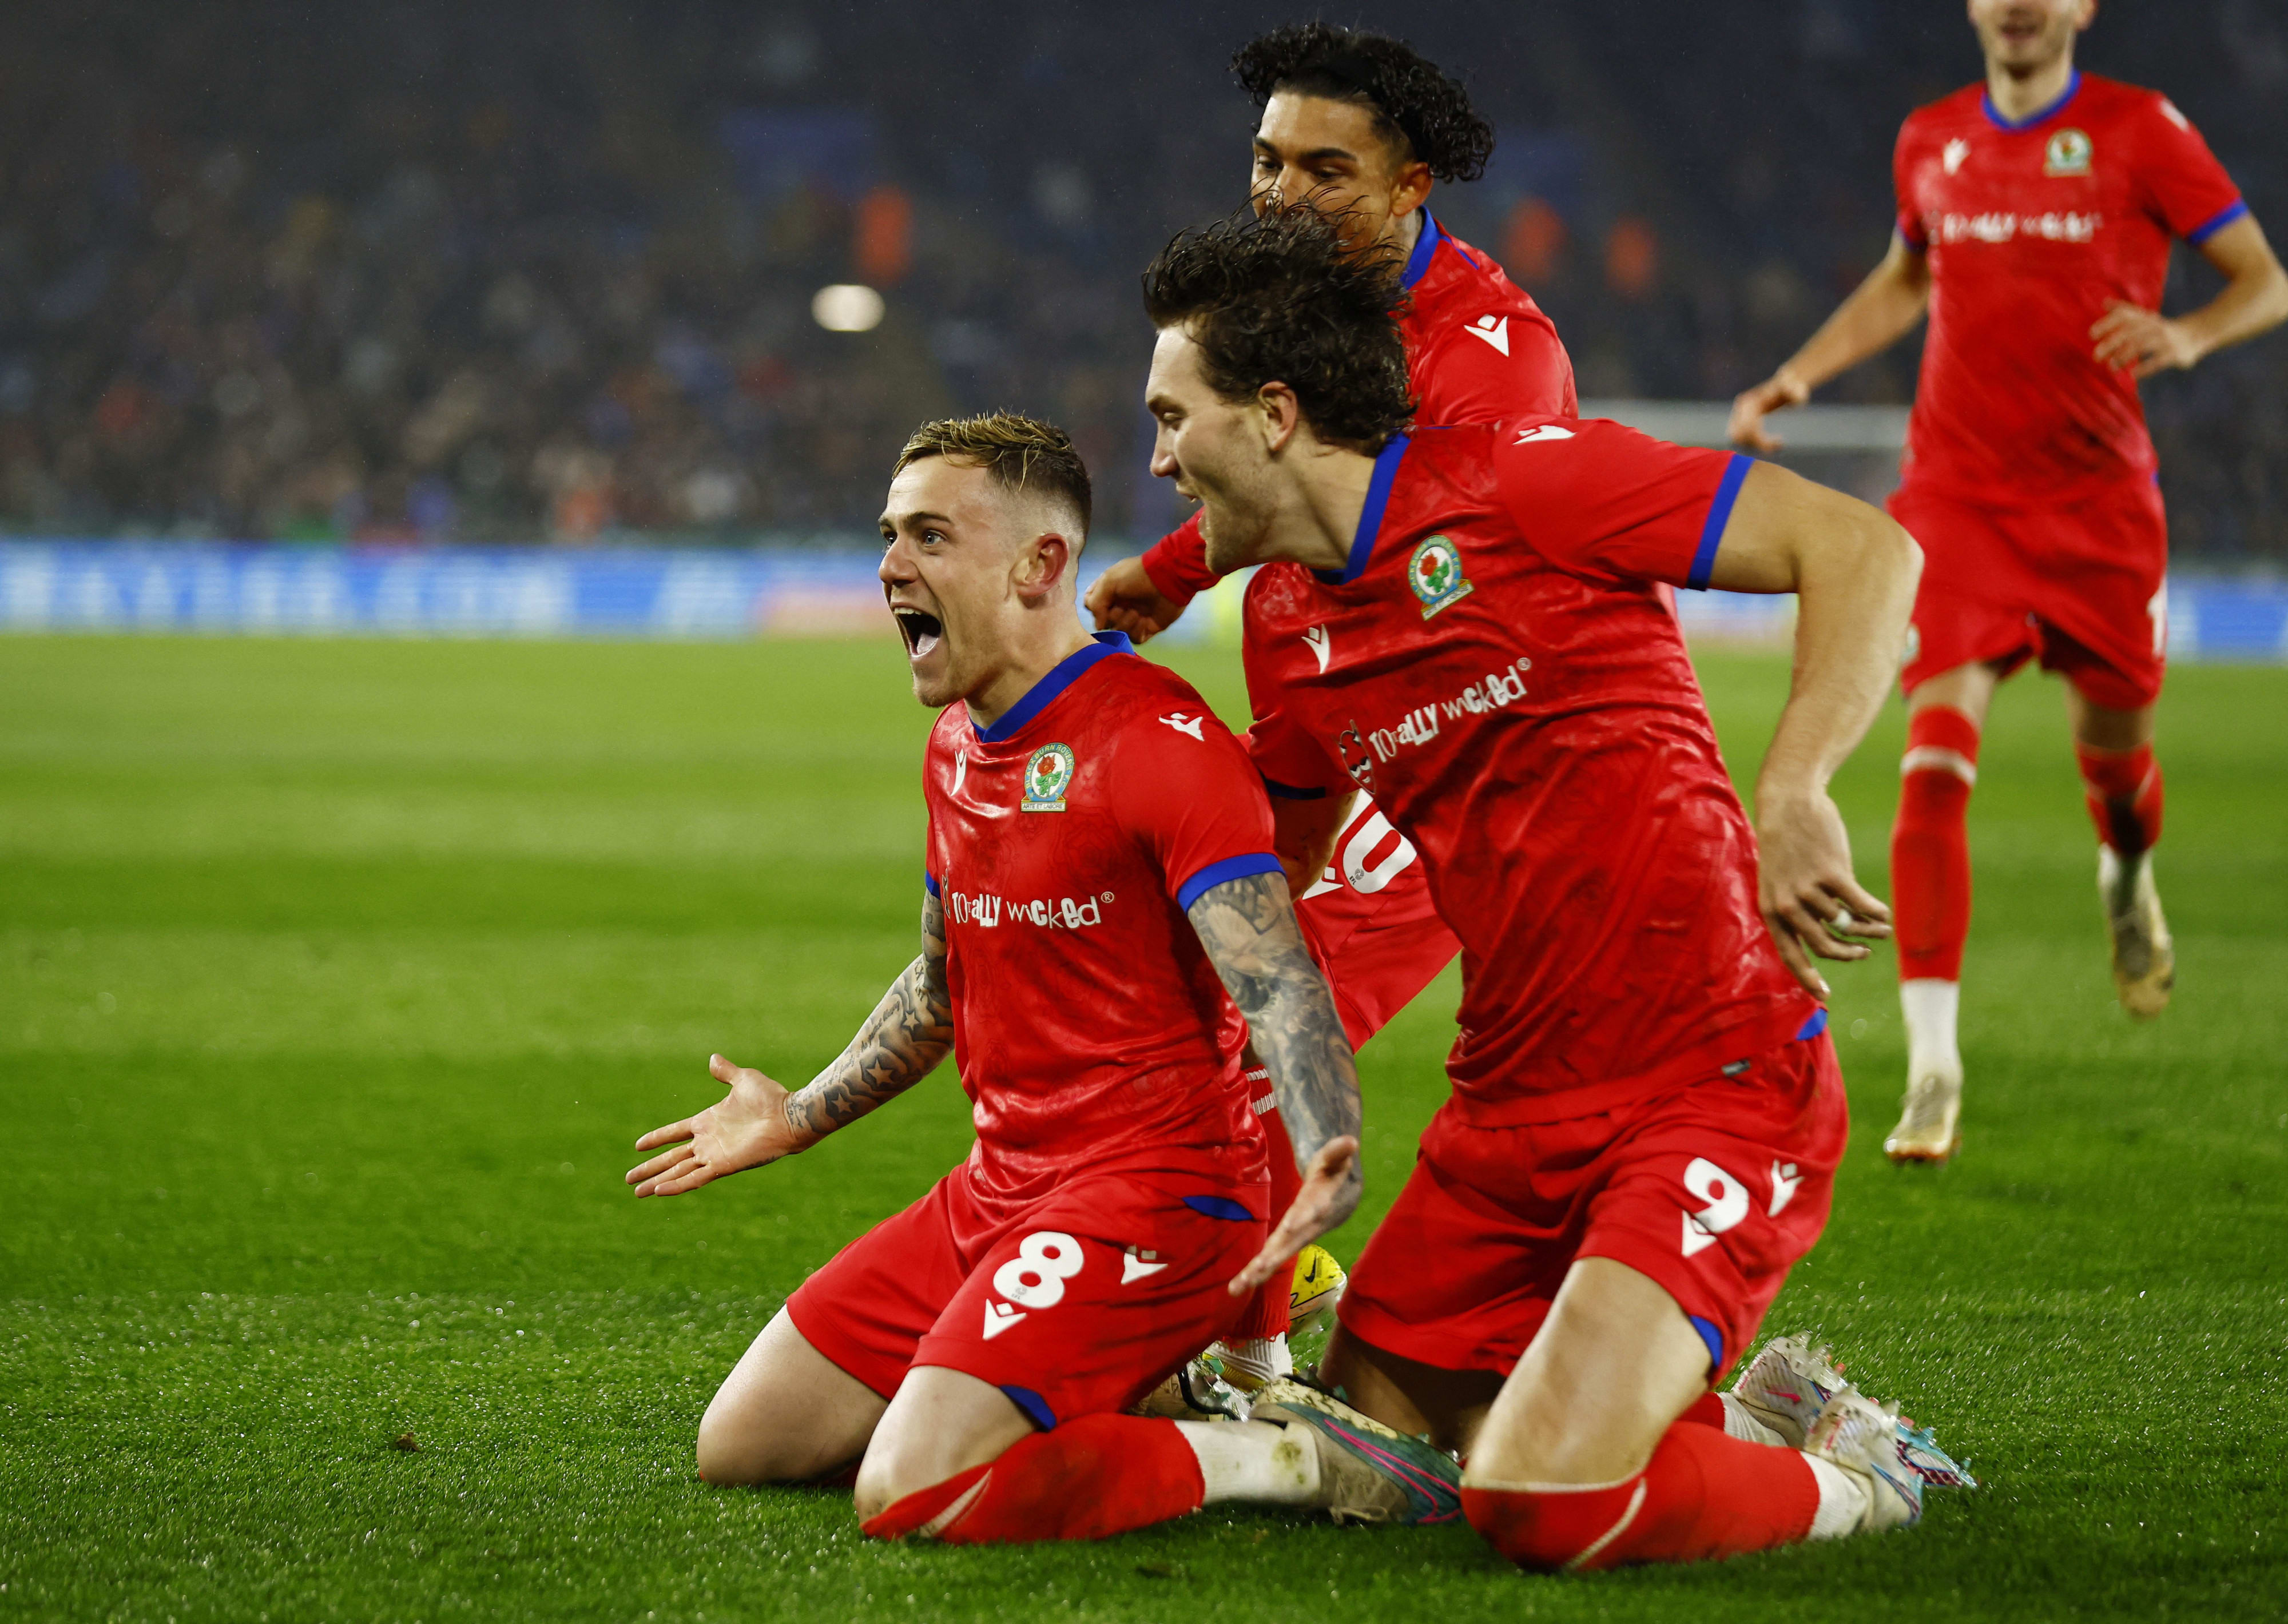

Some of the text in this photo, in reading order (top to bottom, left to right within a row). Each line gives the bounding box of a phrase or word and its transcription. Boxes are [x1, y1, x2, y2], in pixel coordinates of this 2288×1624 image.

[1056, 744, 1072, 770] ROVERS
[1683, 1157, 1750, 1234] 9
[993, 1231, 1084, 1309] 8
